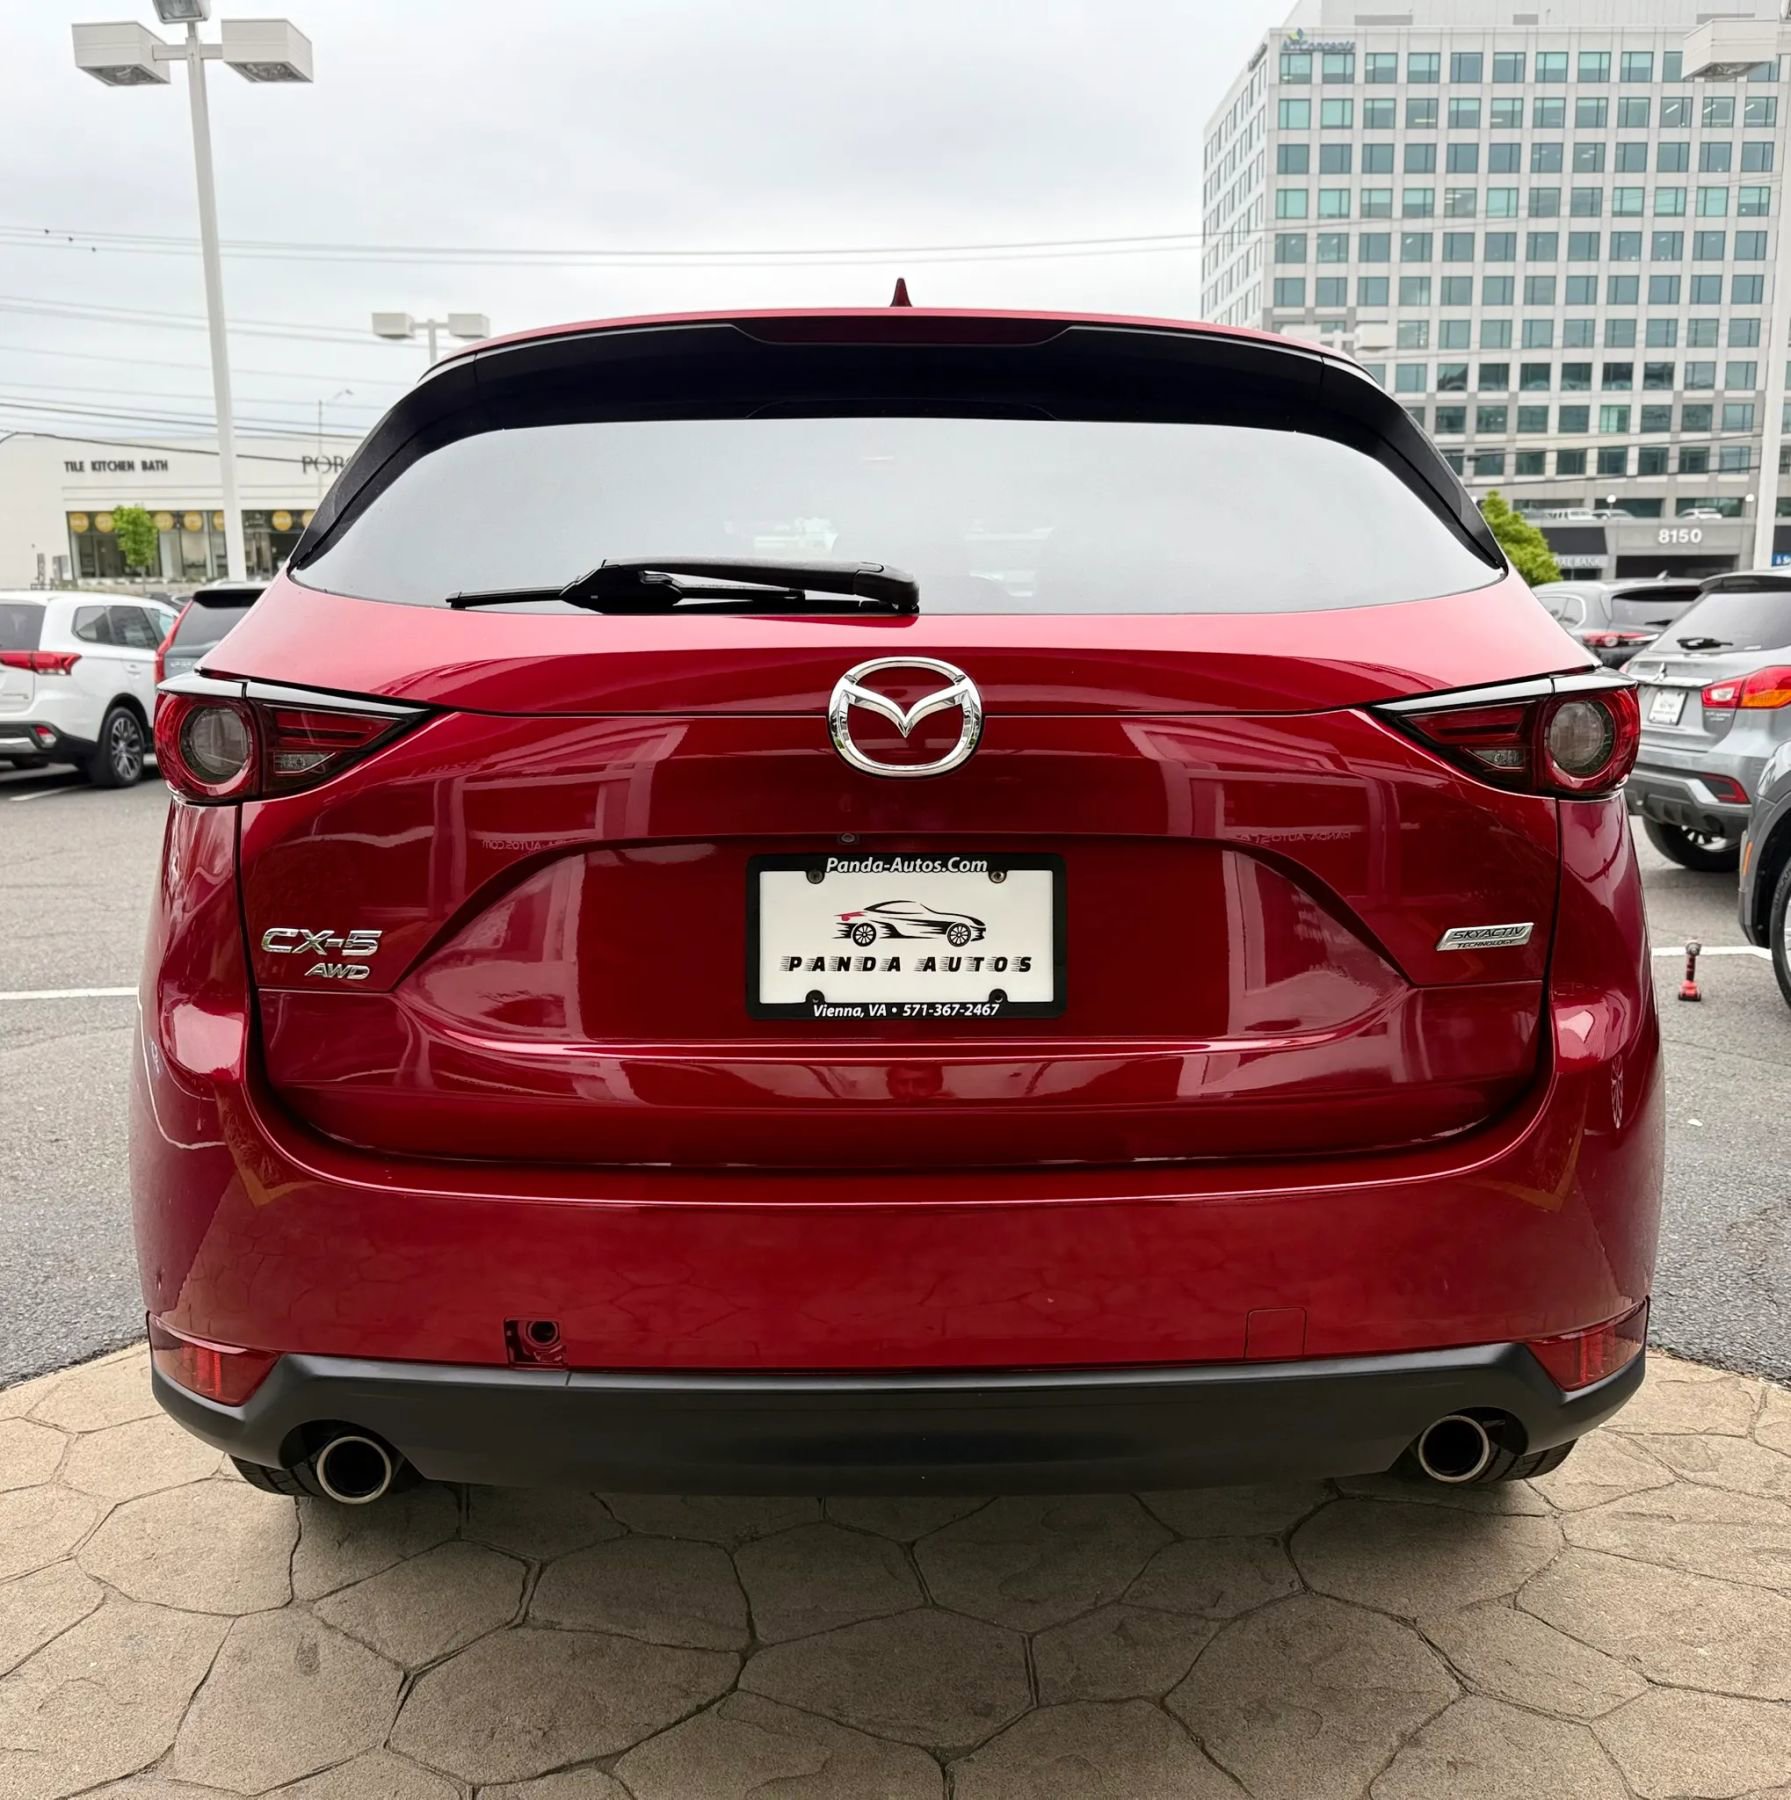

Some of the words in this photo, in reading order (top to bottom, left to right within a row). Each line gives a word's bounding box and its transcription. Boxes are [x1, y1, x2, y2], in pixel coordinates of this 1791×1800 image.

[64, 460, 85, 472] TILE
[91, 460, 135, 472] KITCHEN
[141, 459, 168, 472] BATH
[302, 455, 351, 474] POR
[1658, 528, 1702, 543] 8150
[826, 857, 988, 873] Panda-Autos.Com
[1452, 926, 1526, 940] SKYACTIV
[261, 928, 383, 956] CX-5
[1456, 940, 1514, 949] TECHNOLOGY
[304, 963, 370, 980] AWD
[780, 956, 901, 972] PANDA
[914, 956, 1032, 972] AUTOS
[813, 1004, 864, 1018] Vienna,
[869, 1004, 888, 1016] VA
[902, 1003, 1000, 1017] 571-367-2467
